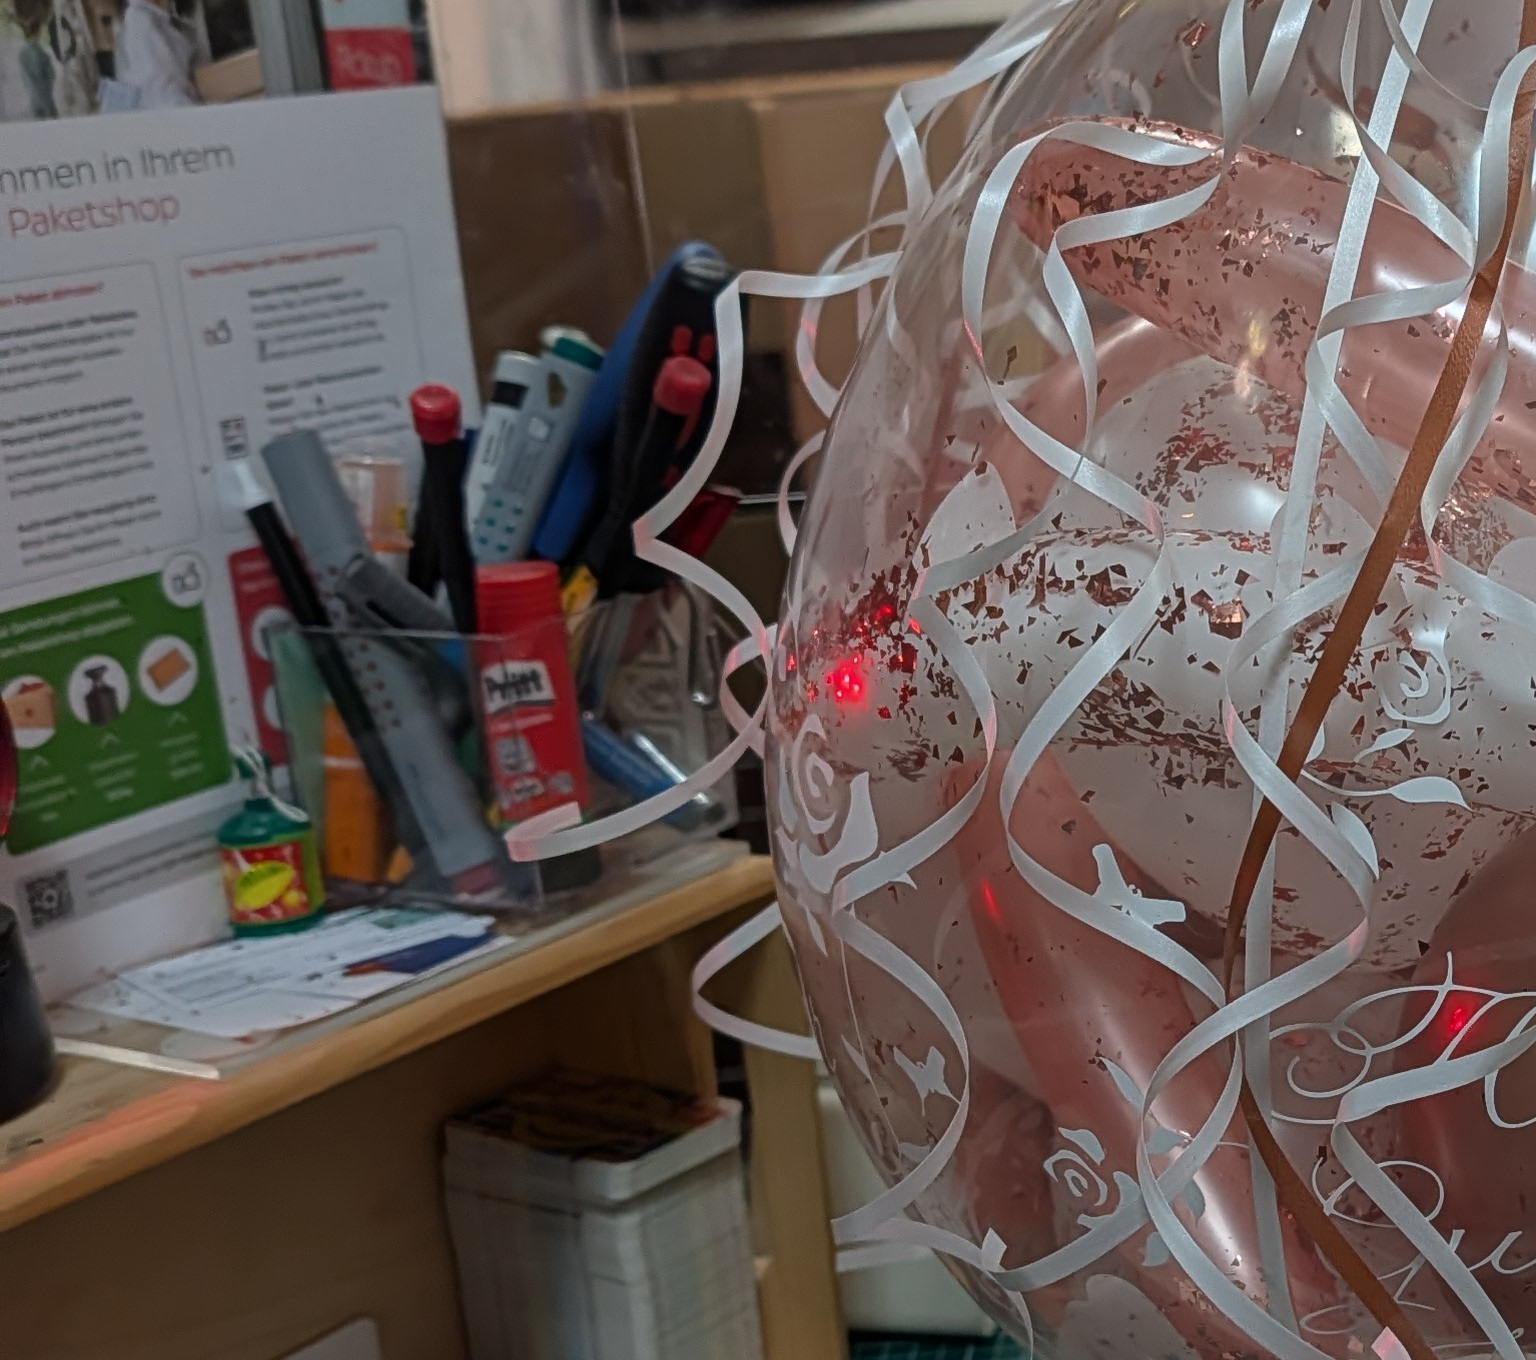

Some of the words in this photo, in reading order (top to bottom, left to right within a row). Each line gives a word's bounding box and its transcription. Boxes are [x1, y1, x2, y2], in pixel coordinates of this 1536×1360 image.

[102, 150, 133, 182] in
[140, 145, 235, 178] Ihrem
[8, 194, 180, 240] Paketshop
